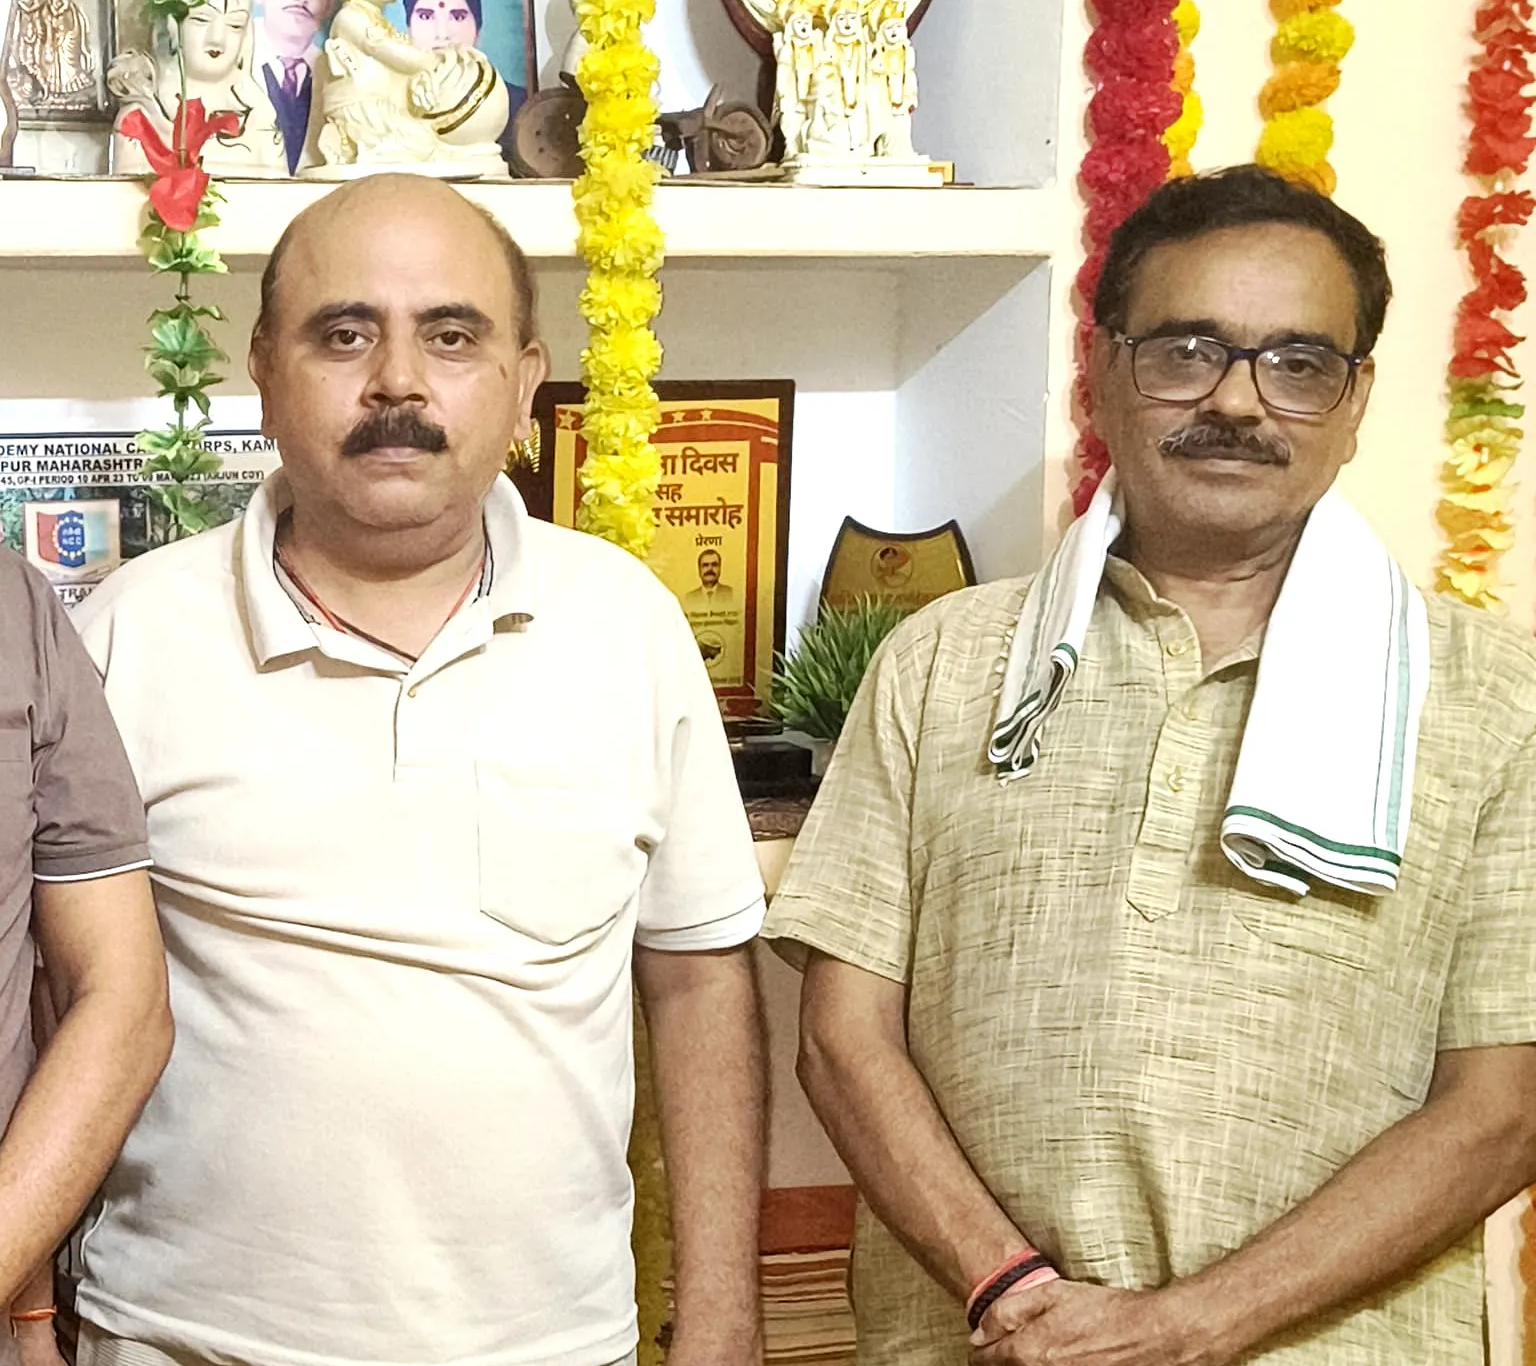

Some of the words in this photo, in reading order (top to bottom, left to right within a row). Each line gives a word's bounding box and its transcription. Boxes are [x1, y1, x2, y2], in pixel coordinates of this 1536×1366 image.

[44, 443, 122, 456] NATIONAL
[36, 458, 151, 472] MAHARASHTR
[680, 446, 740, 476] दिवस
[664, 496, 745, 529] समारोह
[694, 533, 723, 547] प्रेरणा
